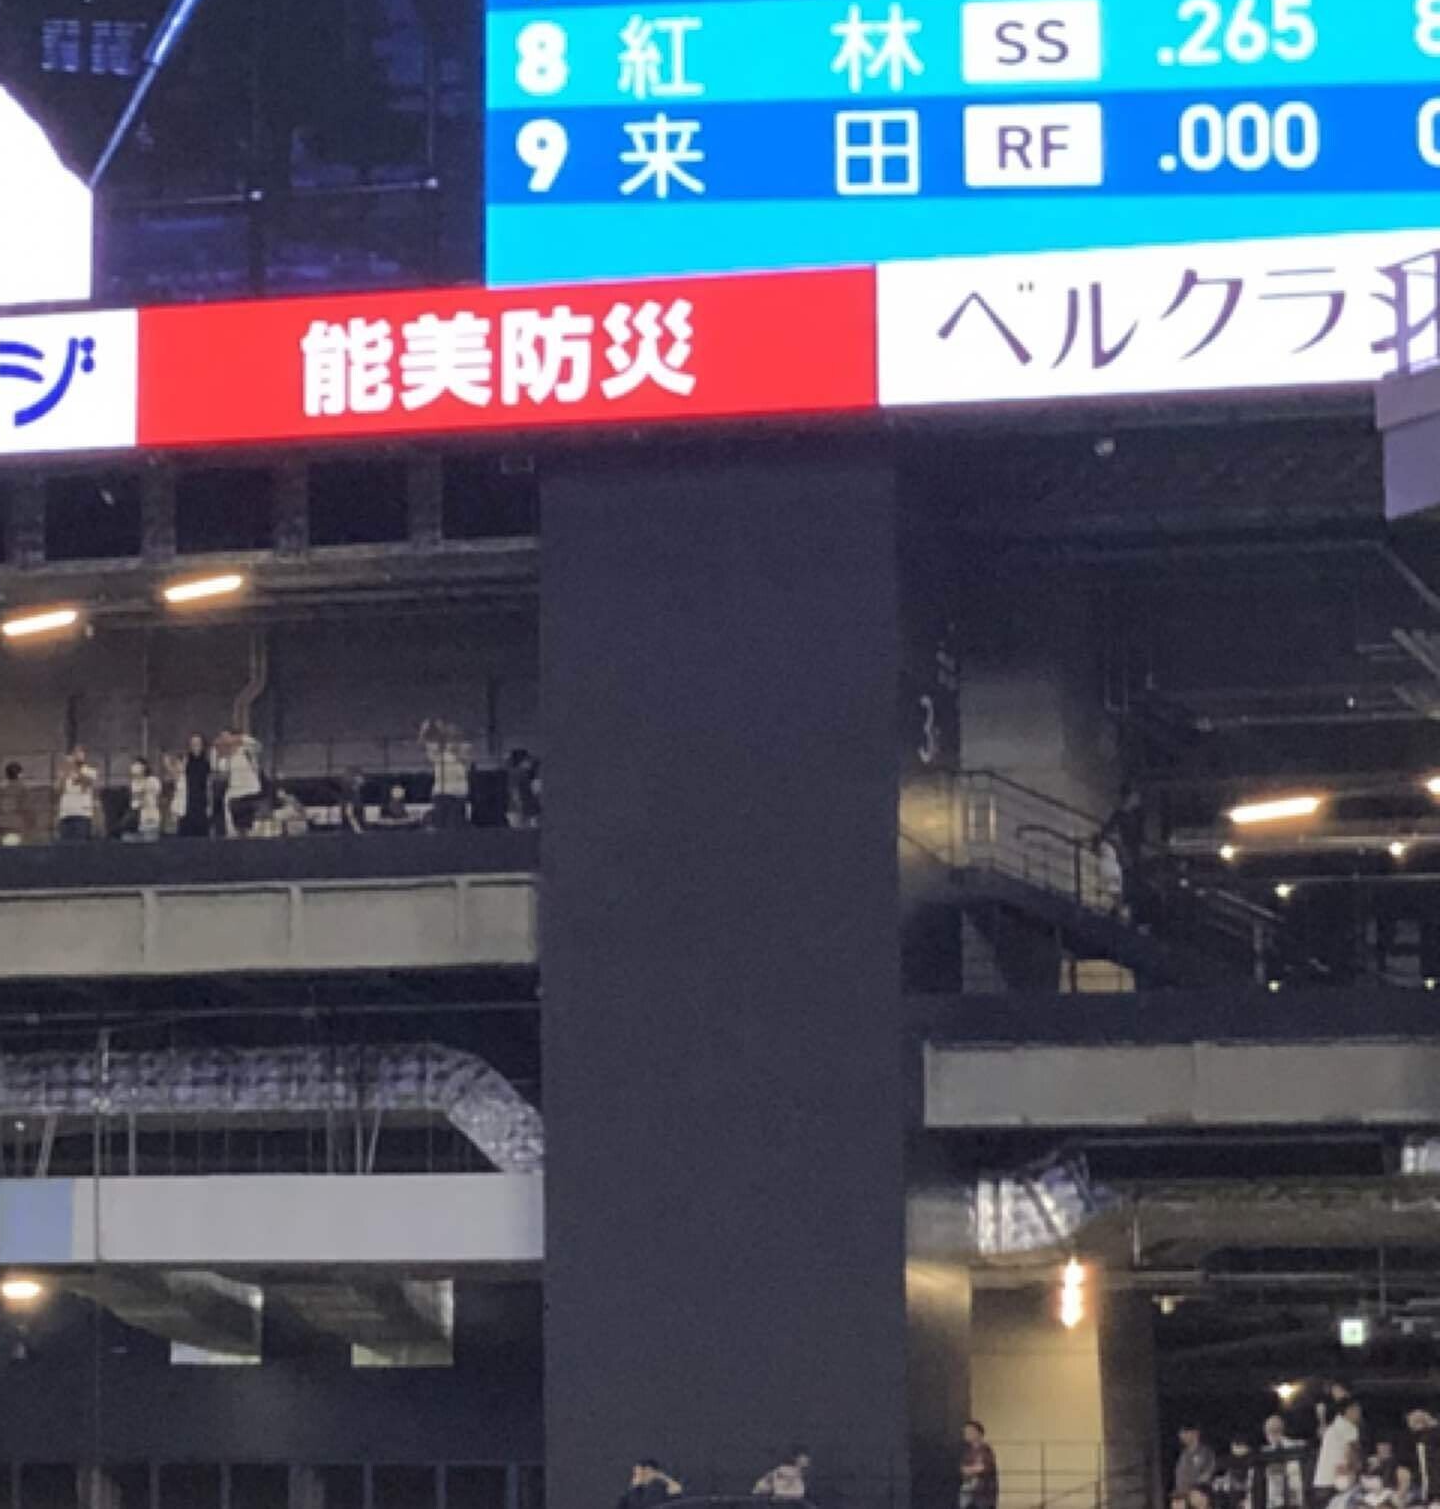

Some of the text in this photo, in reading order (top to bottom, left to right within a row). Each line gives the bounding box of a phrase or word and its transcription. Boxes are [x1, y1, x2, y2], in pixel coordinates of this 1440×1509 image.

[517, 22, 567, 94] 8
[996, 20, 1068, 65] SS
[517, 119, 567, 191] 9
[999, 126, 1068, 168] RF
[1161, 102, 1318, 170] .000
[300, 298, 697, 416] 能美防災
